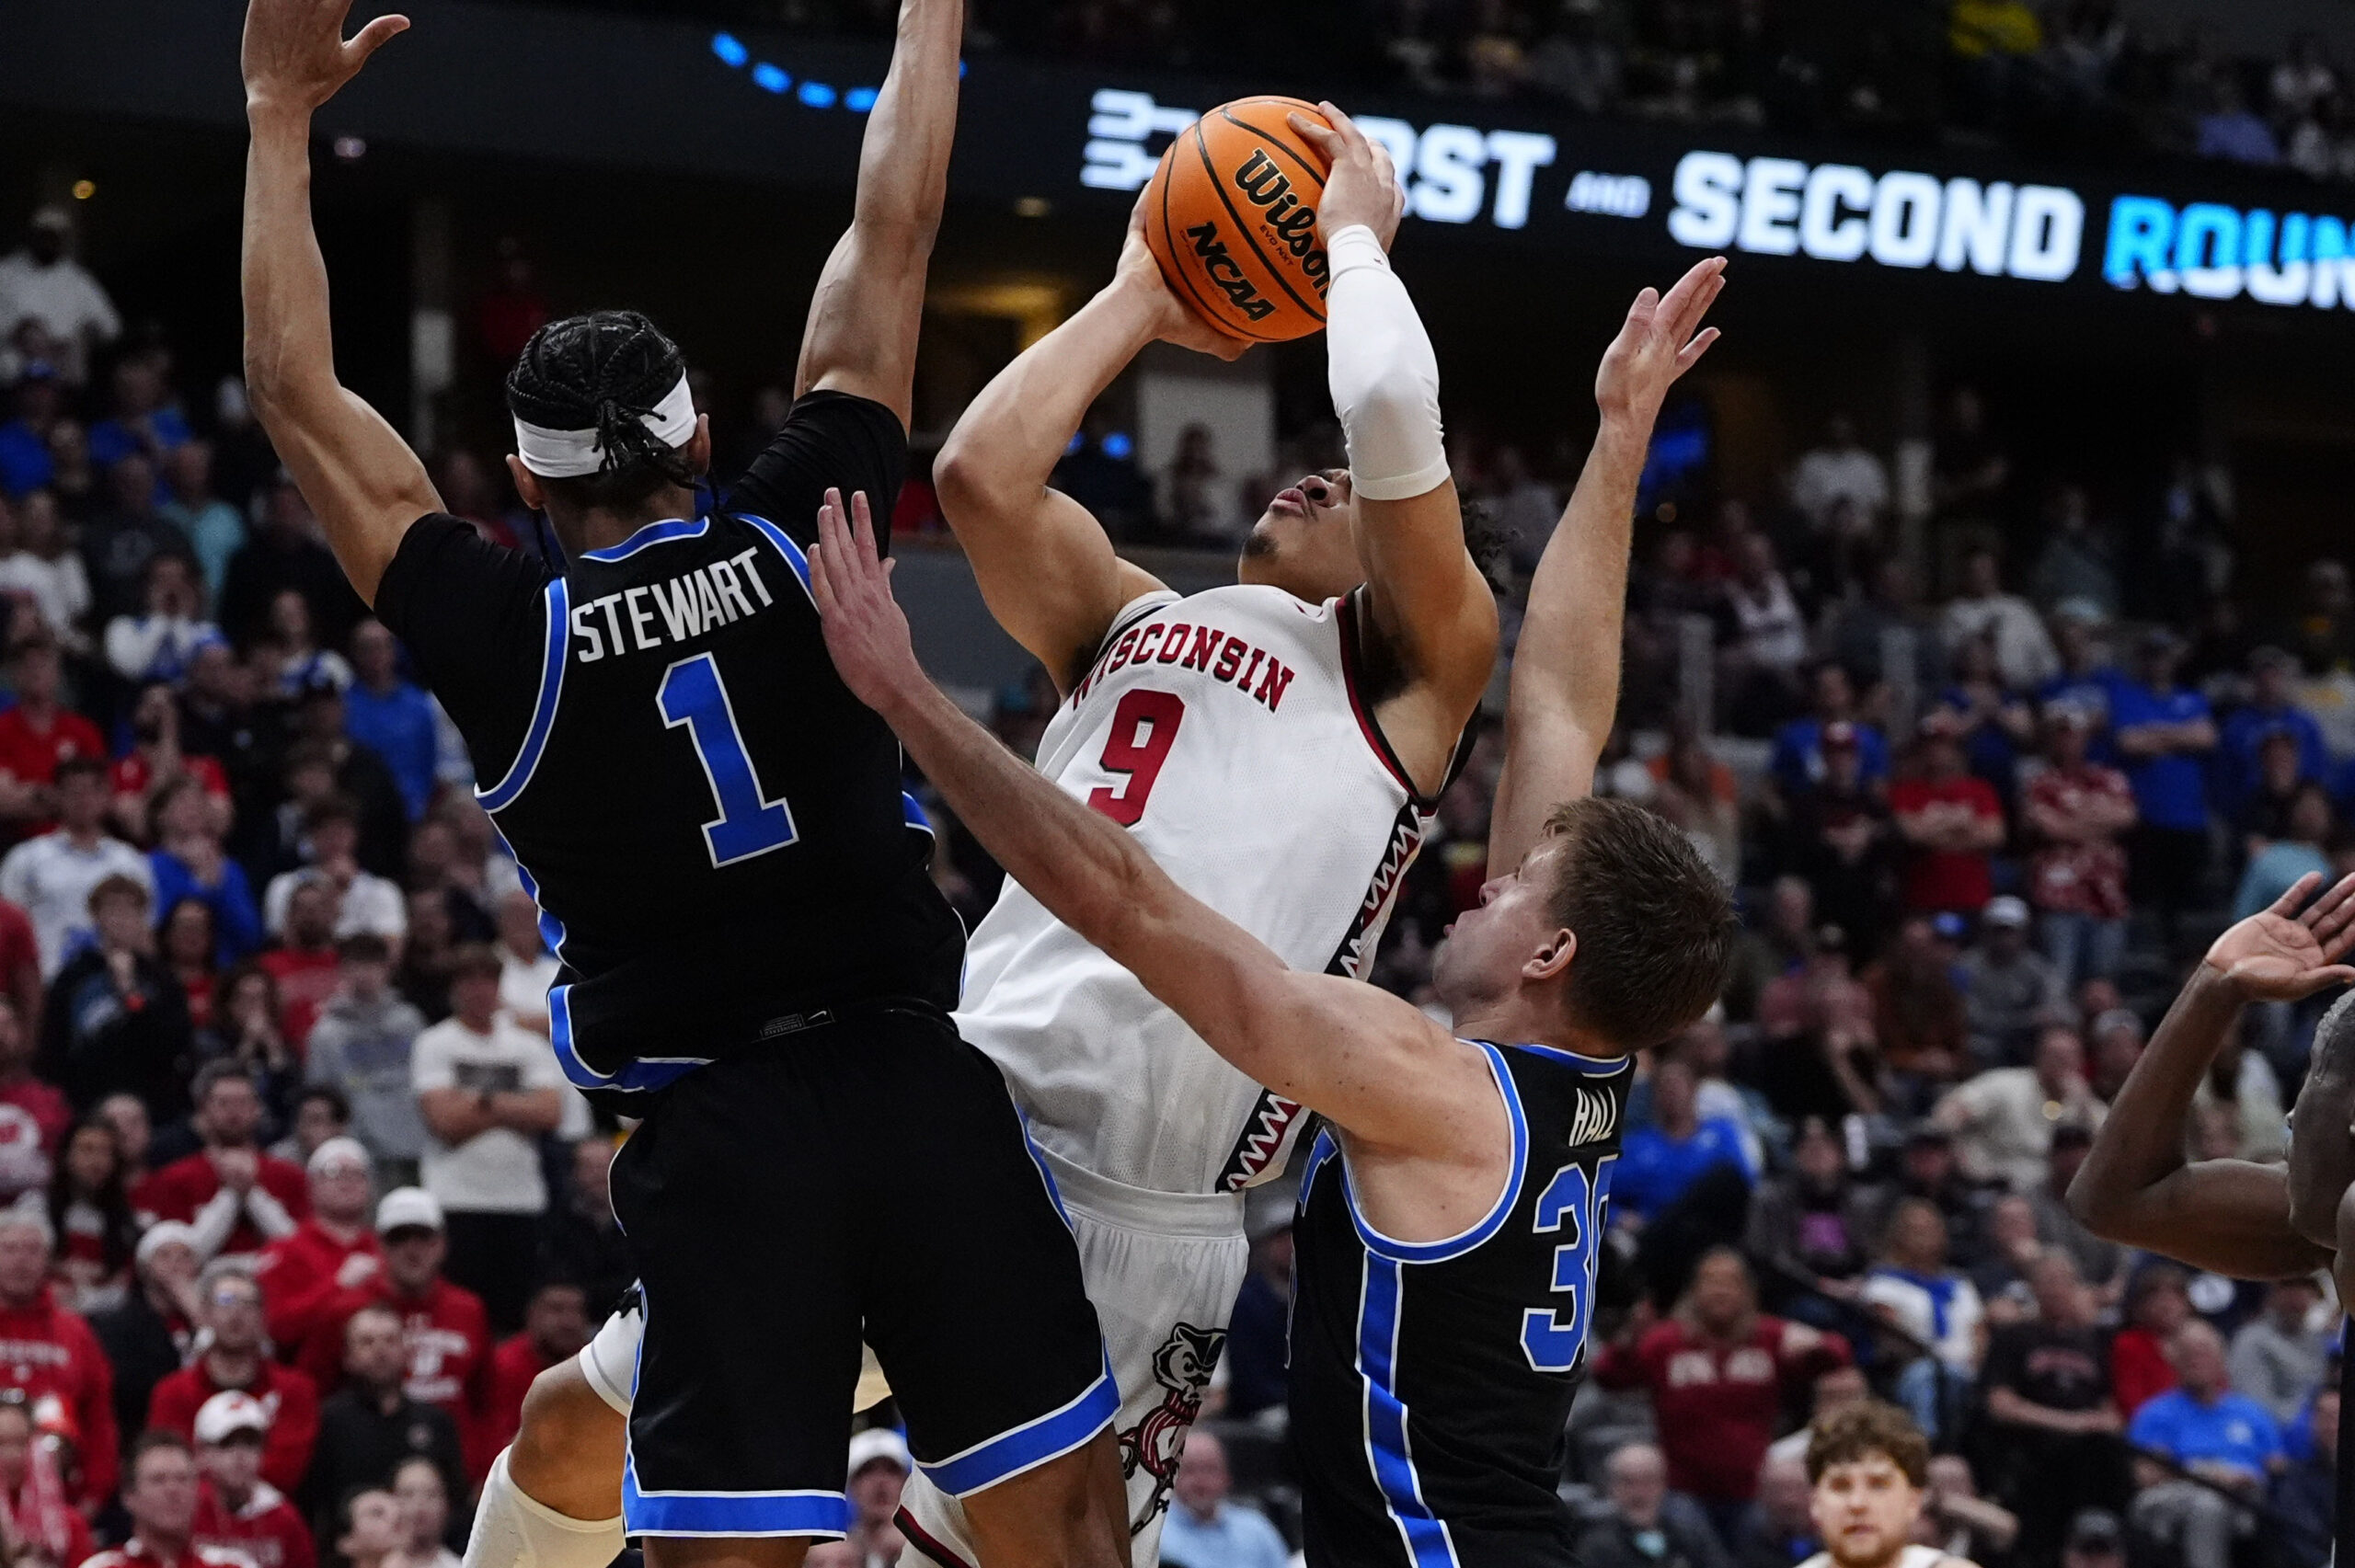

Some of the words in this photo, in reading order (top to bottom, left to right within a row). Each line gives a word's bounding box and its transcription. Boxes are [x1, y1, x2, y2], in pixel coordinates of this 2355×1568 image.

[1186, 220, 1277, 323] NCAA
[1259, 224, 1278, 246] EVO
[1276, 246, 1294, 266] NXT
[1666, 149, 2085, 284] SECOND
[570, 545, 774, 663] STEWART
[655, 650, 800, 869] 1
[1086, 688, 1186, 829] 9
[1568, 1086, 1617, 1147] HALL
